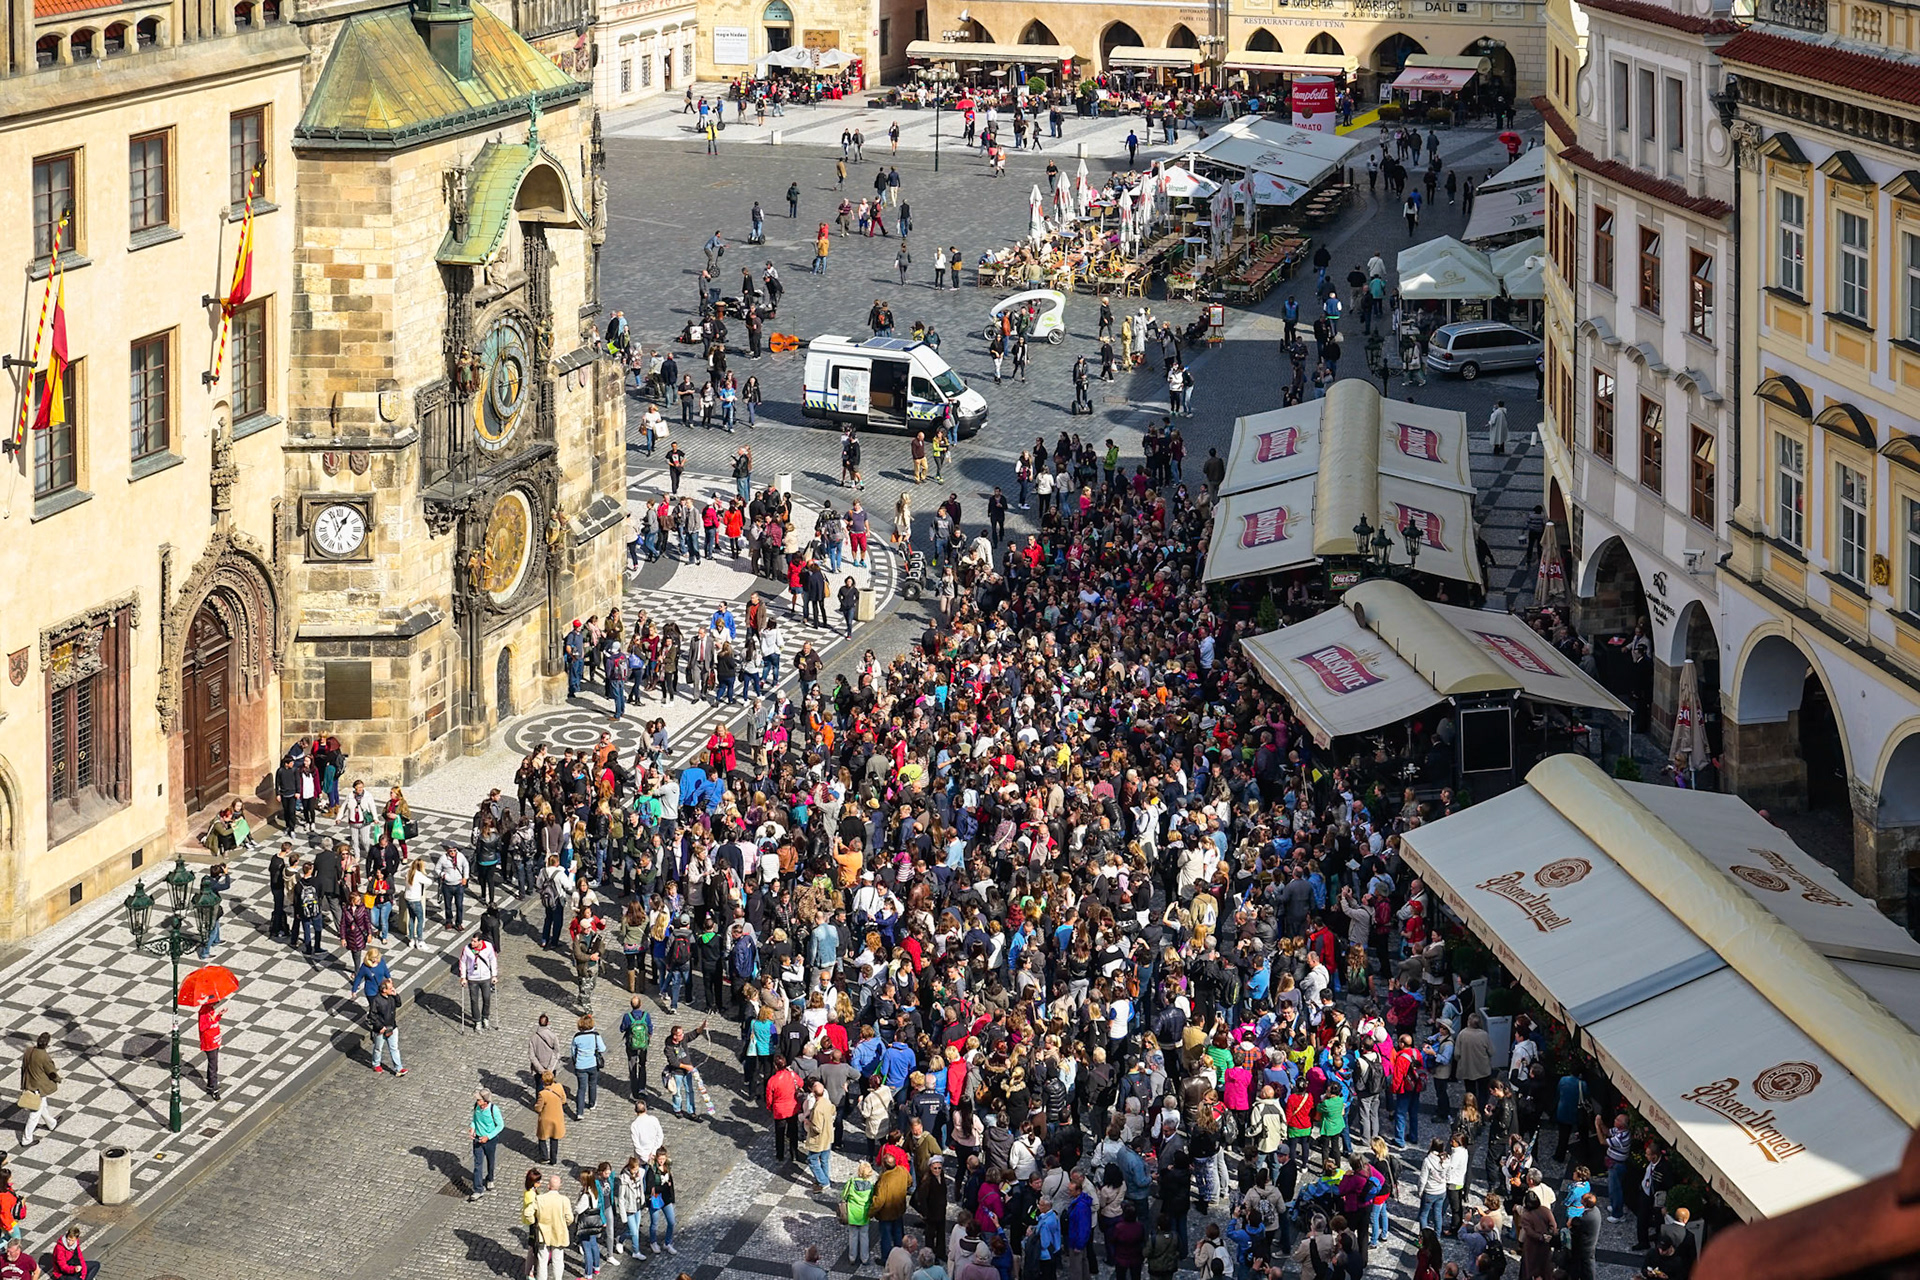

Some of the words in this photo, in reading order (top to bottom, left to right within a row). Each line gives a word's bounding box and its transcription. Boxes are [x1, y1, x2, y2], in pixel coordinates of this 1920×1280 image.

[1243, 17, 1293, 26] RESTAURANT
[1312, 647, 1368, 690] KRUŠOVICE
[1475, 871, 1536, 901] Pilsner
[1525, 893, 1572, 931] Urquell
[1680, 1077, 1758, 1122] Pilsner
[1746, 1109, 1806, 1160] Urquell
